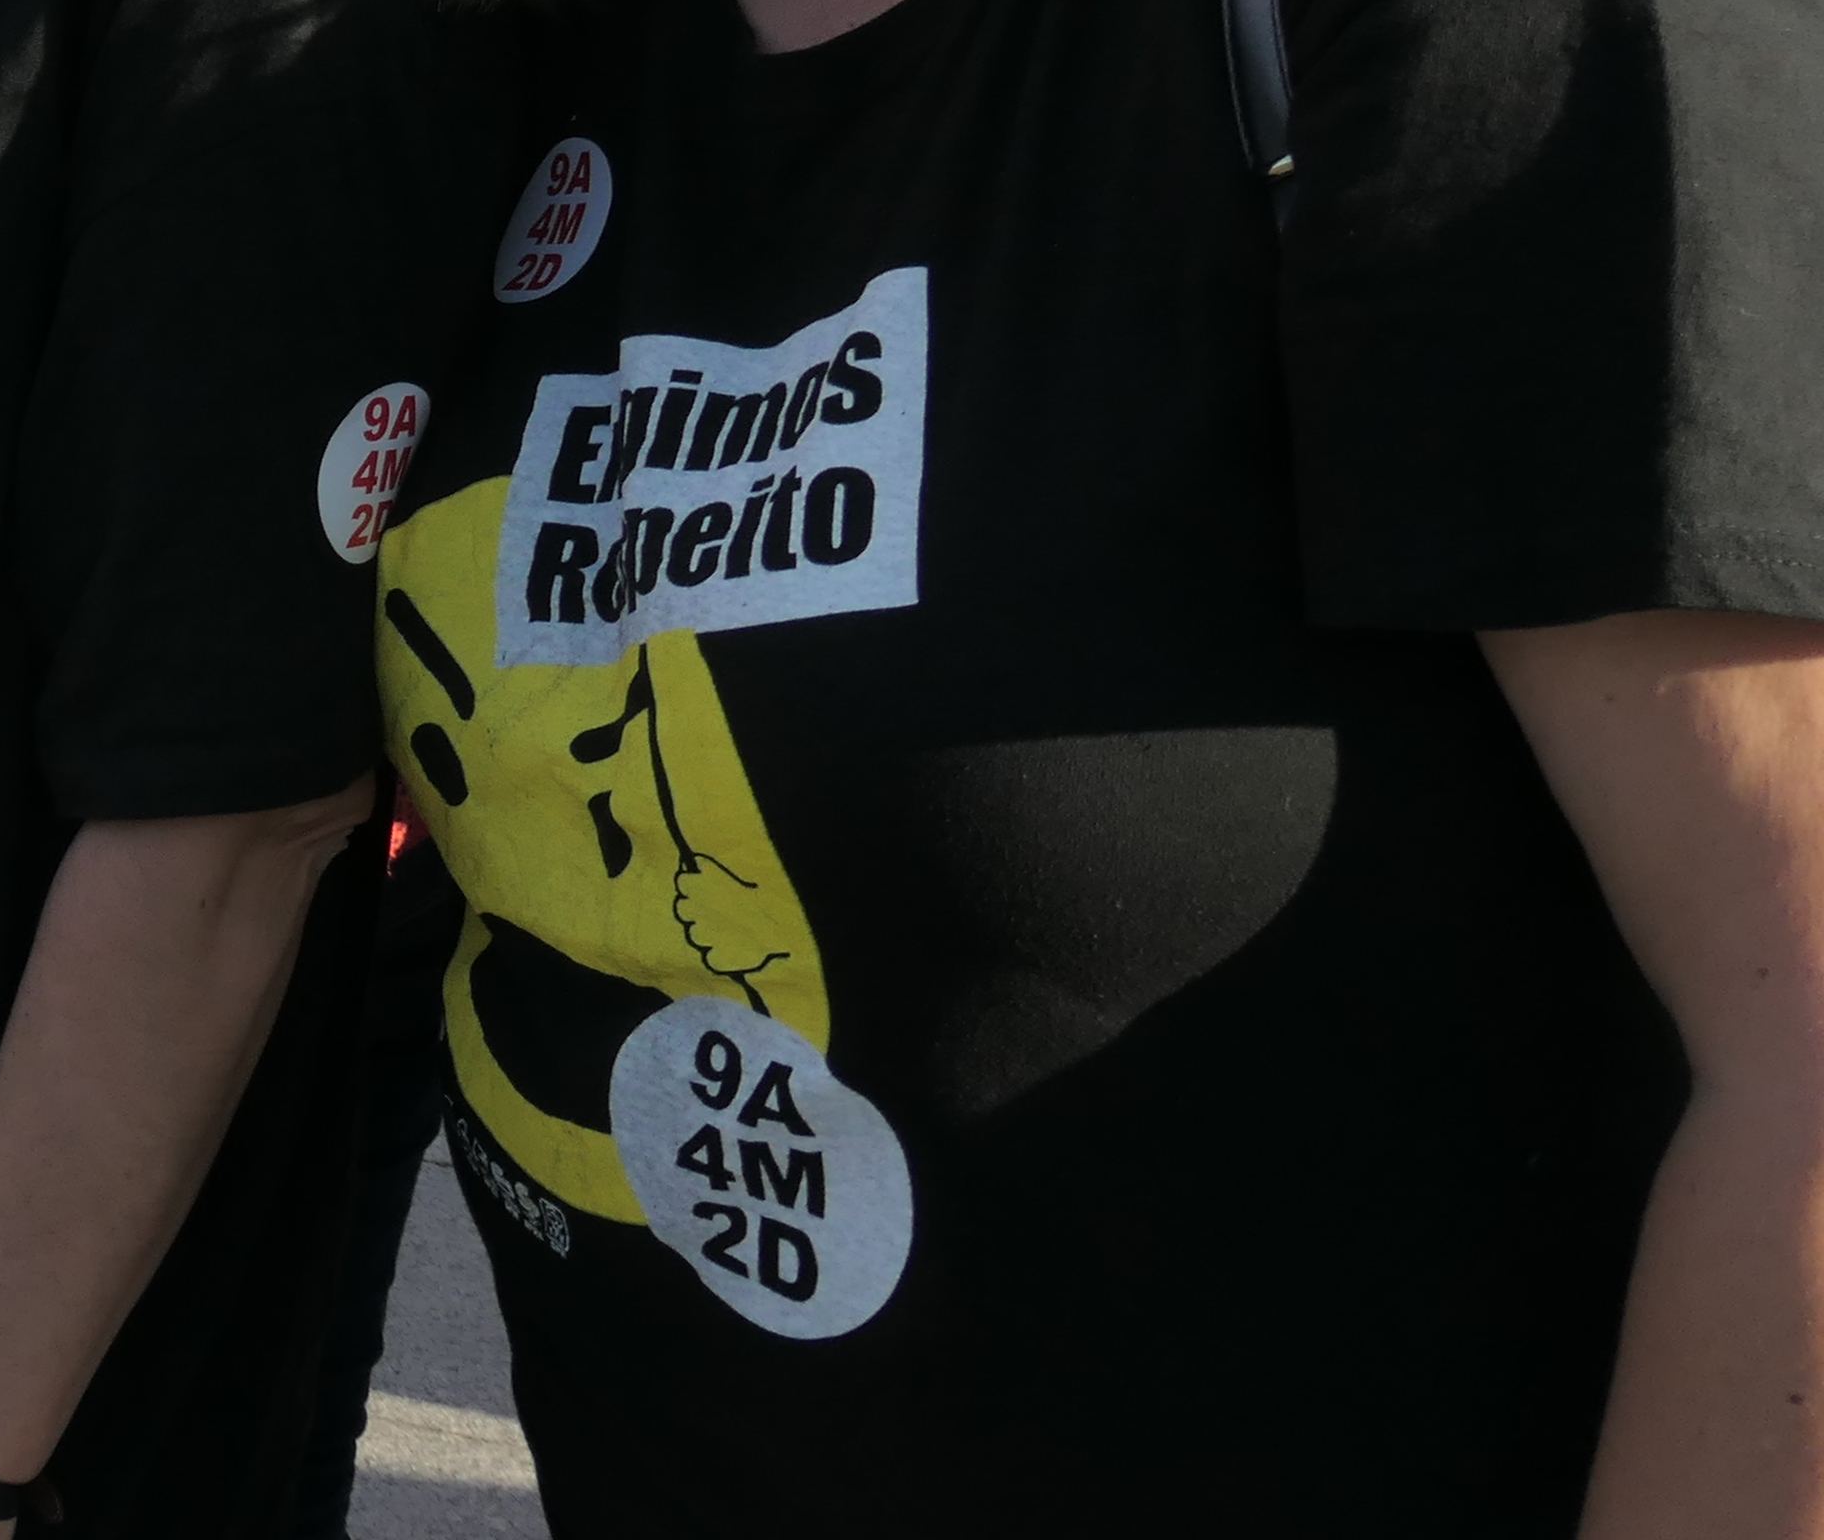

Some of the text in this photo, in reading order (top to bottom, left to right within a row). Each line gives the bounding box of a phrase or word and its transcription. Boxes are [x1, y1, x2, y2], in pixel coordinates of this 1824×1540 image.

[546, 150, 591, 196] 9A
[526, 202, 587, 245] 4M
[501, 253, 564, 291] 2D
[363, 394, 417, 442] 9A
[352, 445, 412, 494] 4M
[689, 1030, 816, 1138] 9A
[675, 1123, 826, 1219] 4M
[692, 1201, 819, 1303] 2D
